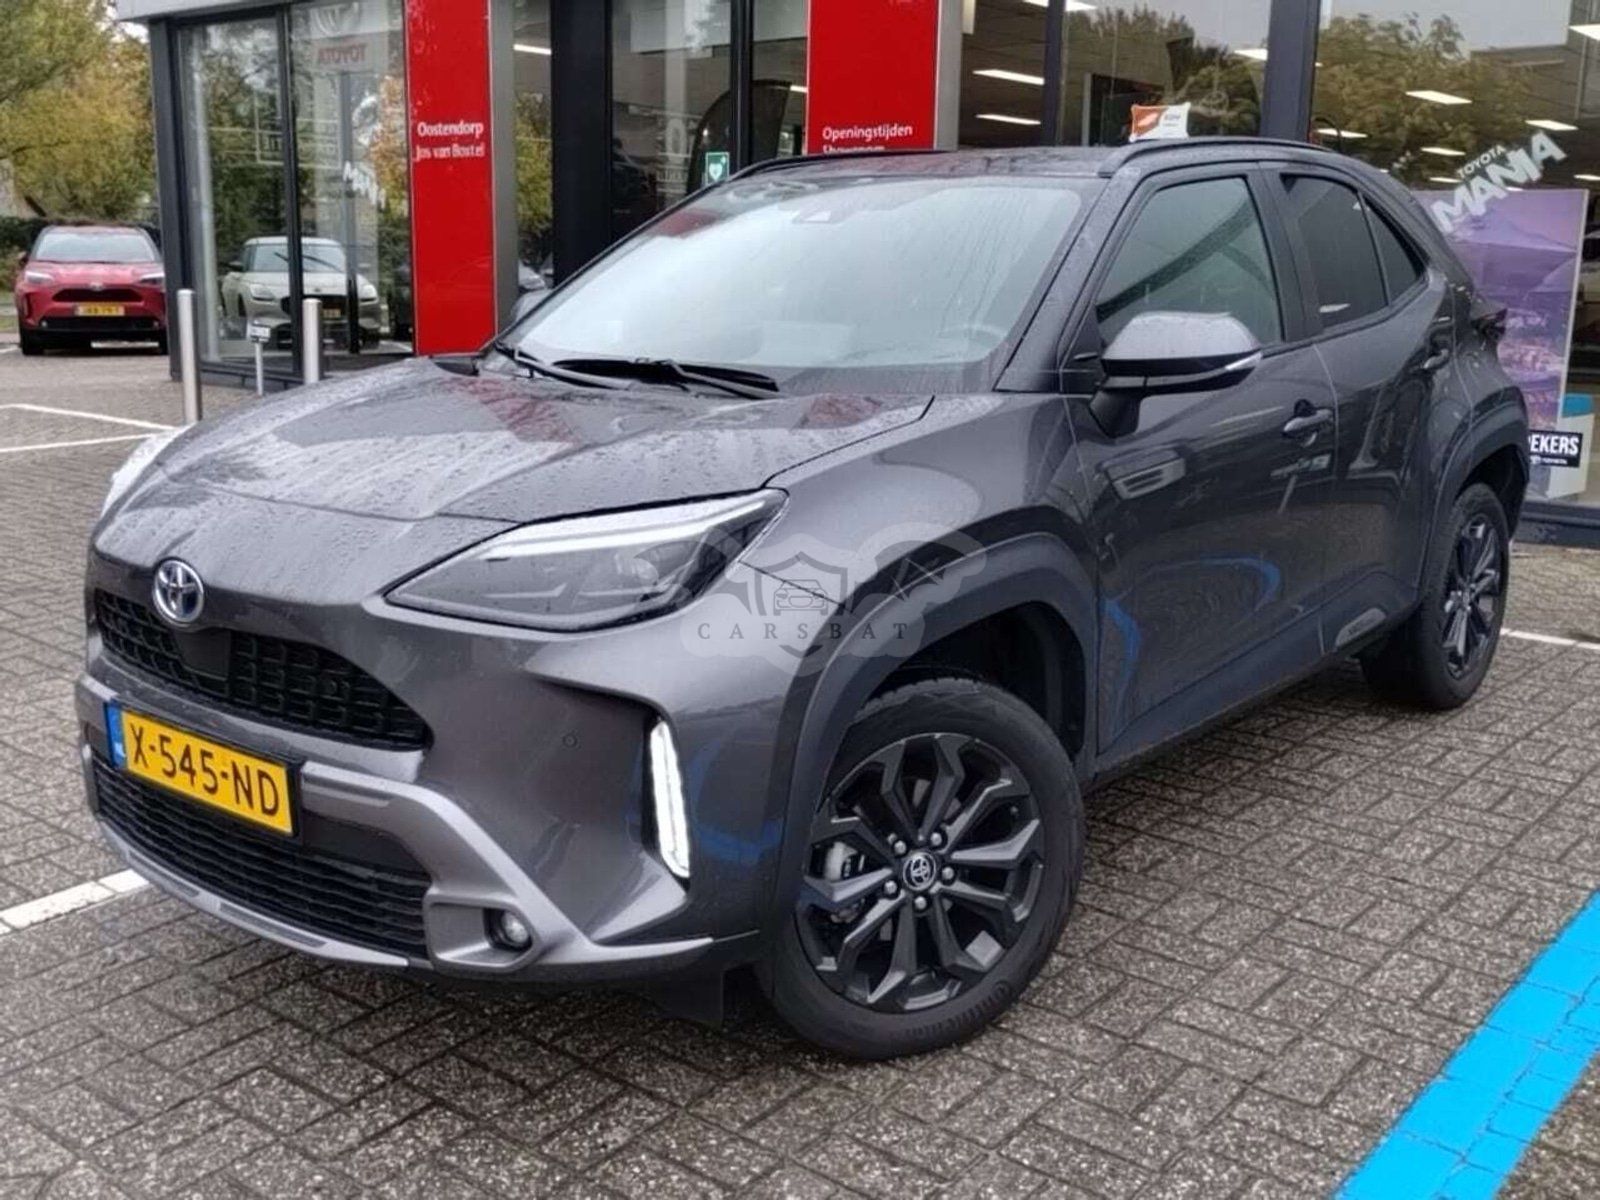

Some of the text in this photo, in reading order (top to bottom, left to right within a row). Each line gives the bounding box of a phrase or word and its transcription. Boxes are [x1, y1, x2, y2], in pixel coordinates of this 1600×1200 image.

[417, 120, 485, 139] Oostendorp
[822, 123, 913, 142] Openingstijden
[1456, 145, 1507, 178] TOYOTA
[1430, 130, 1567, 232] MANIA
[1528, 433, 1580, 456] EKERS
[129, 722, 279, 816] X-545-ND
